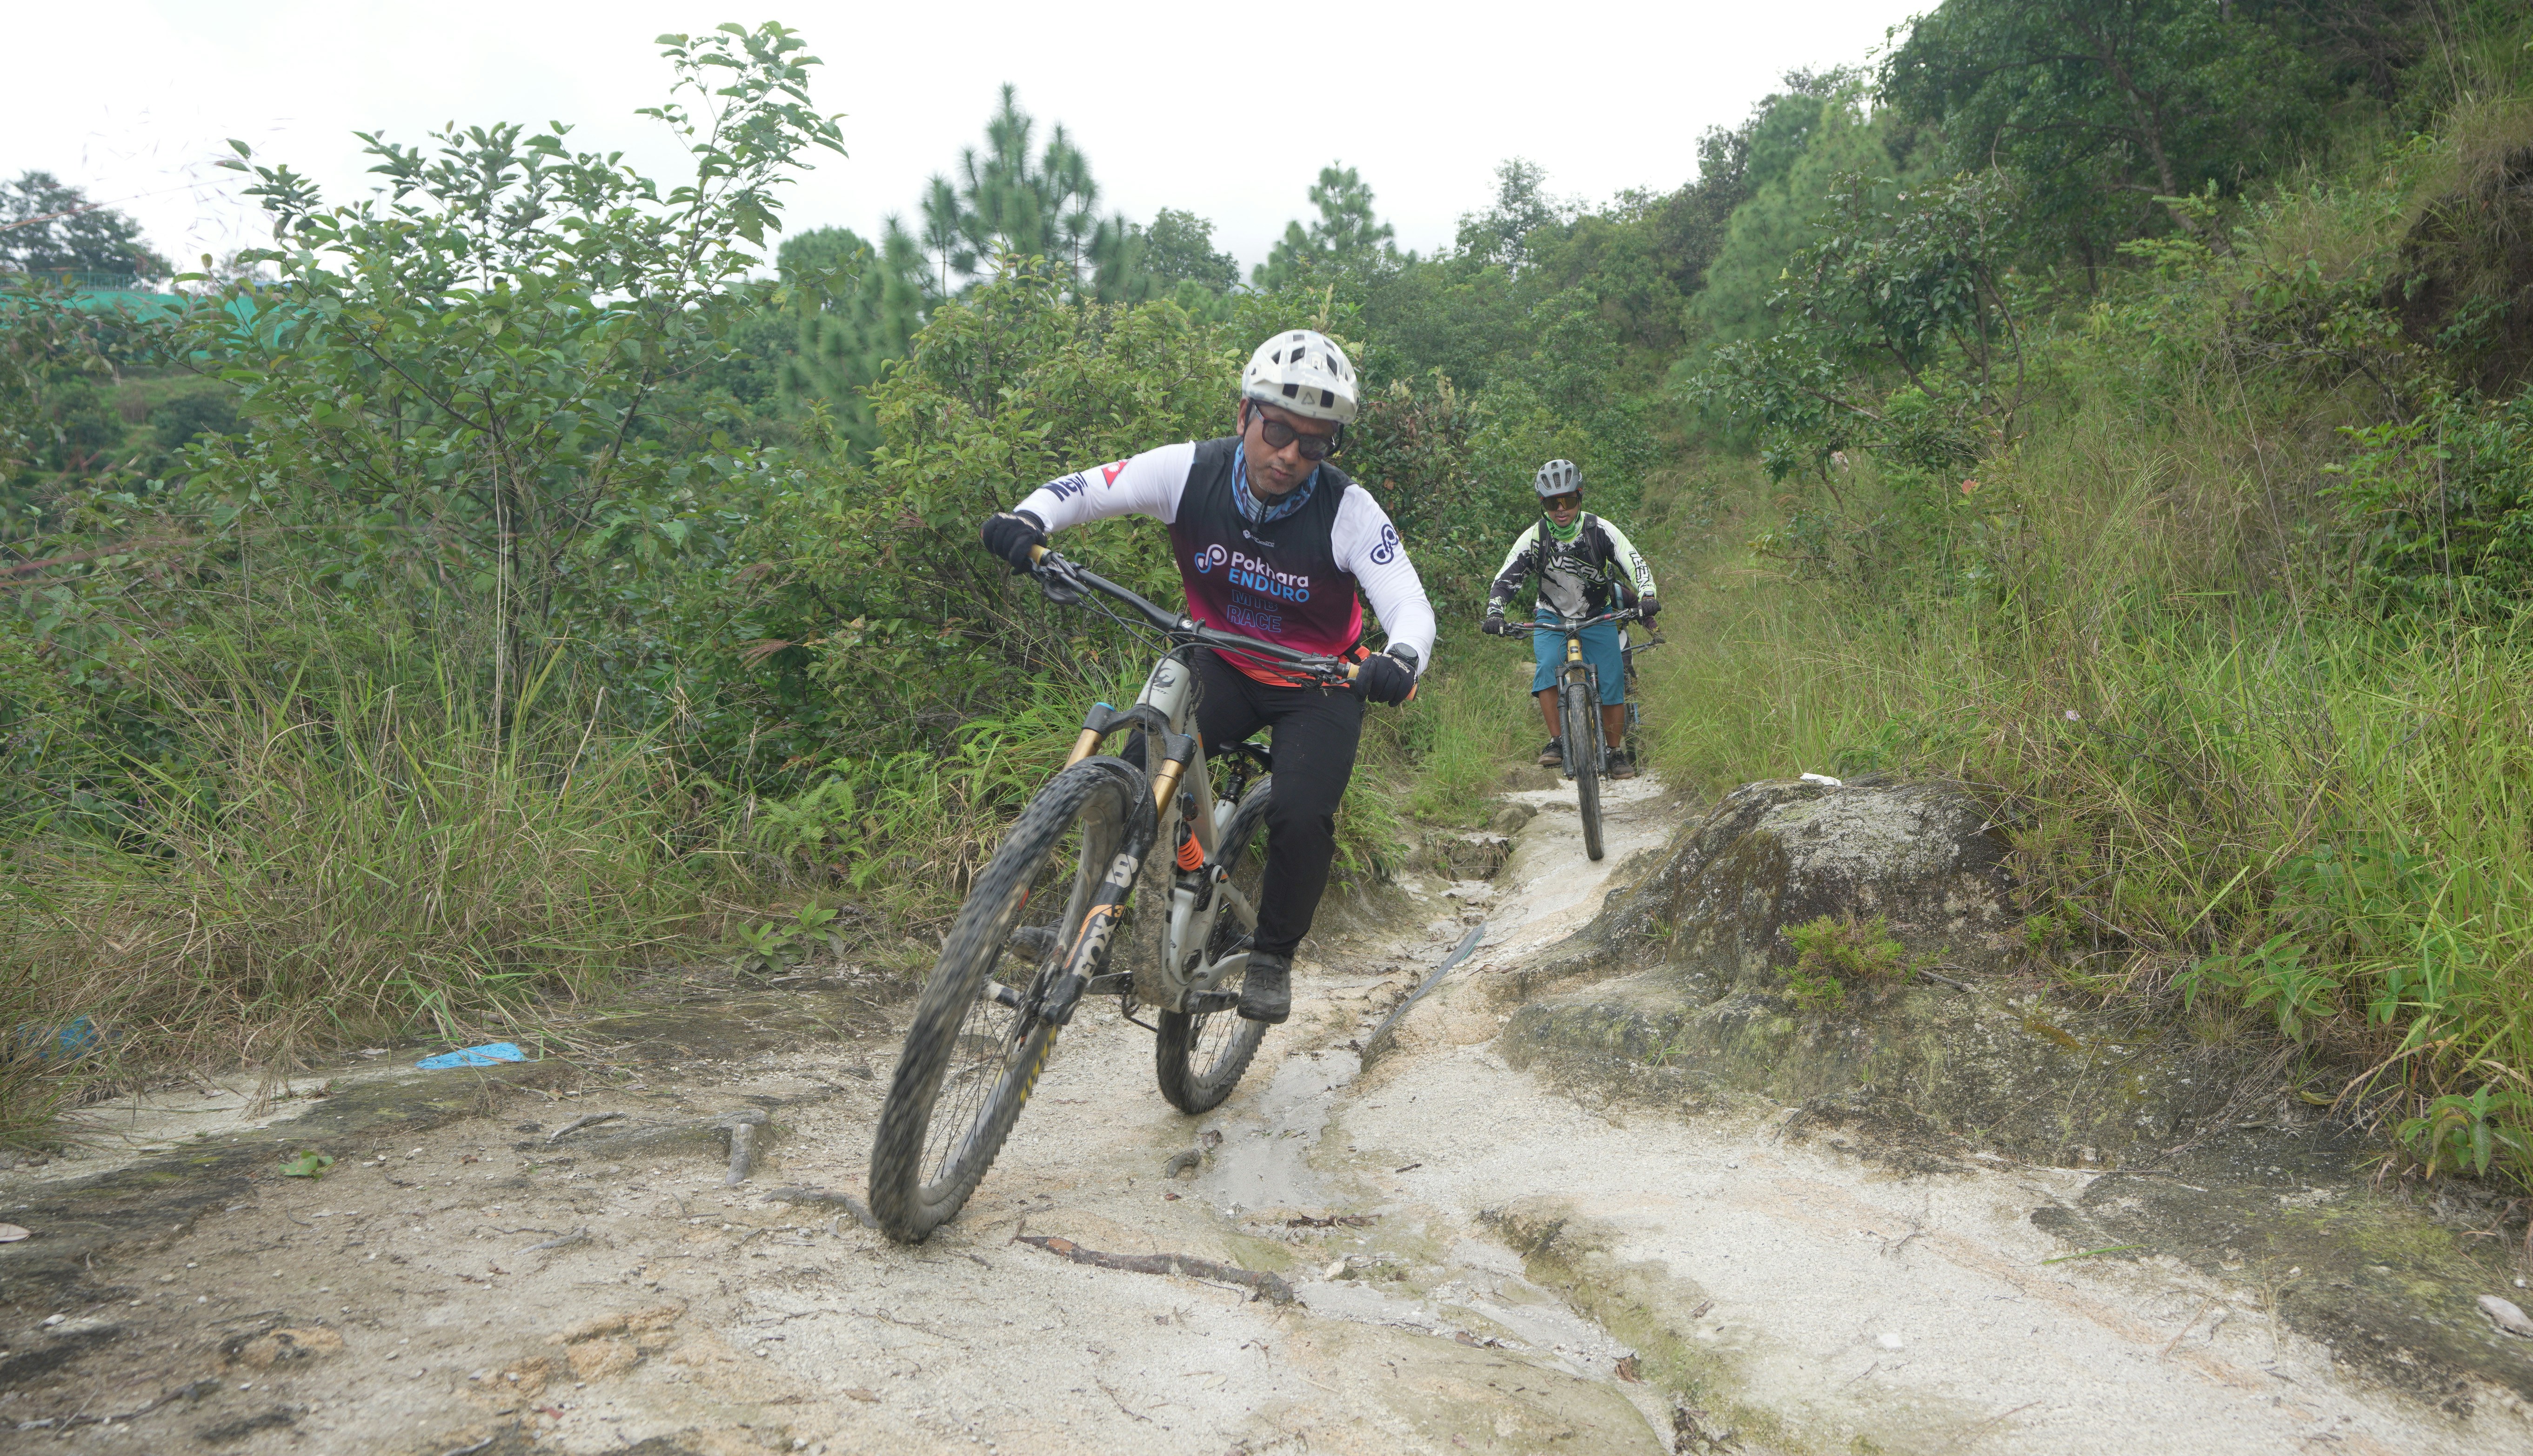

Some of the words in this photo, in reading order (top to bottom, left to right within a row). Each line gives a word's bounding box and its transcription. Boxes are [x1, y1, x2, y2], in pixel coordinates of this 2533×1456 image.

[1231, 551, 1309, 587] Pokhara
[1228, 568, 1310, 602] ENDURO
[1232, 589, 1278, 612] MTB
[1227, 605, 1282, 633] RACE
